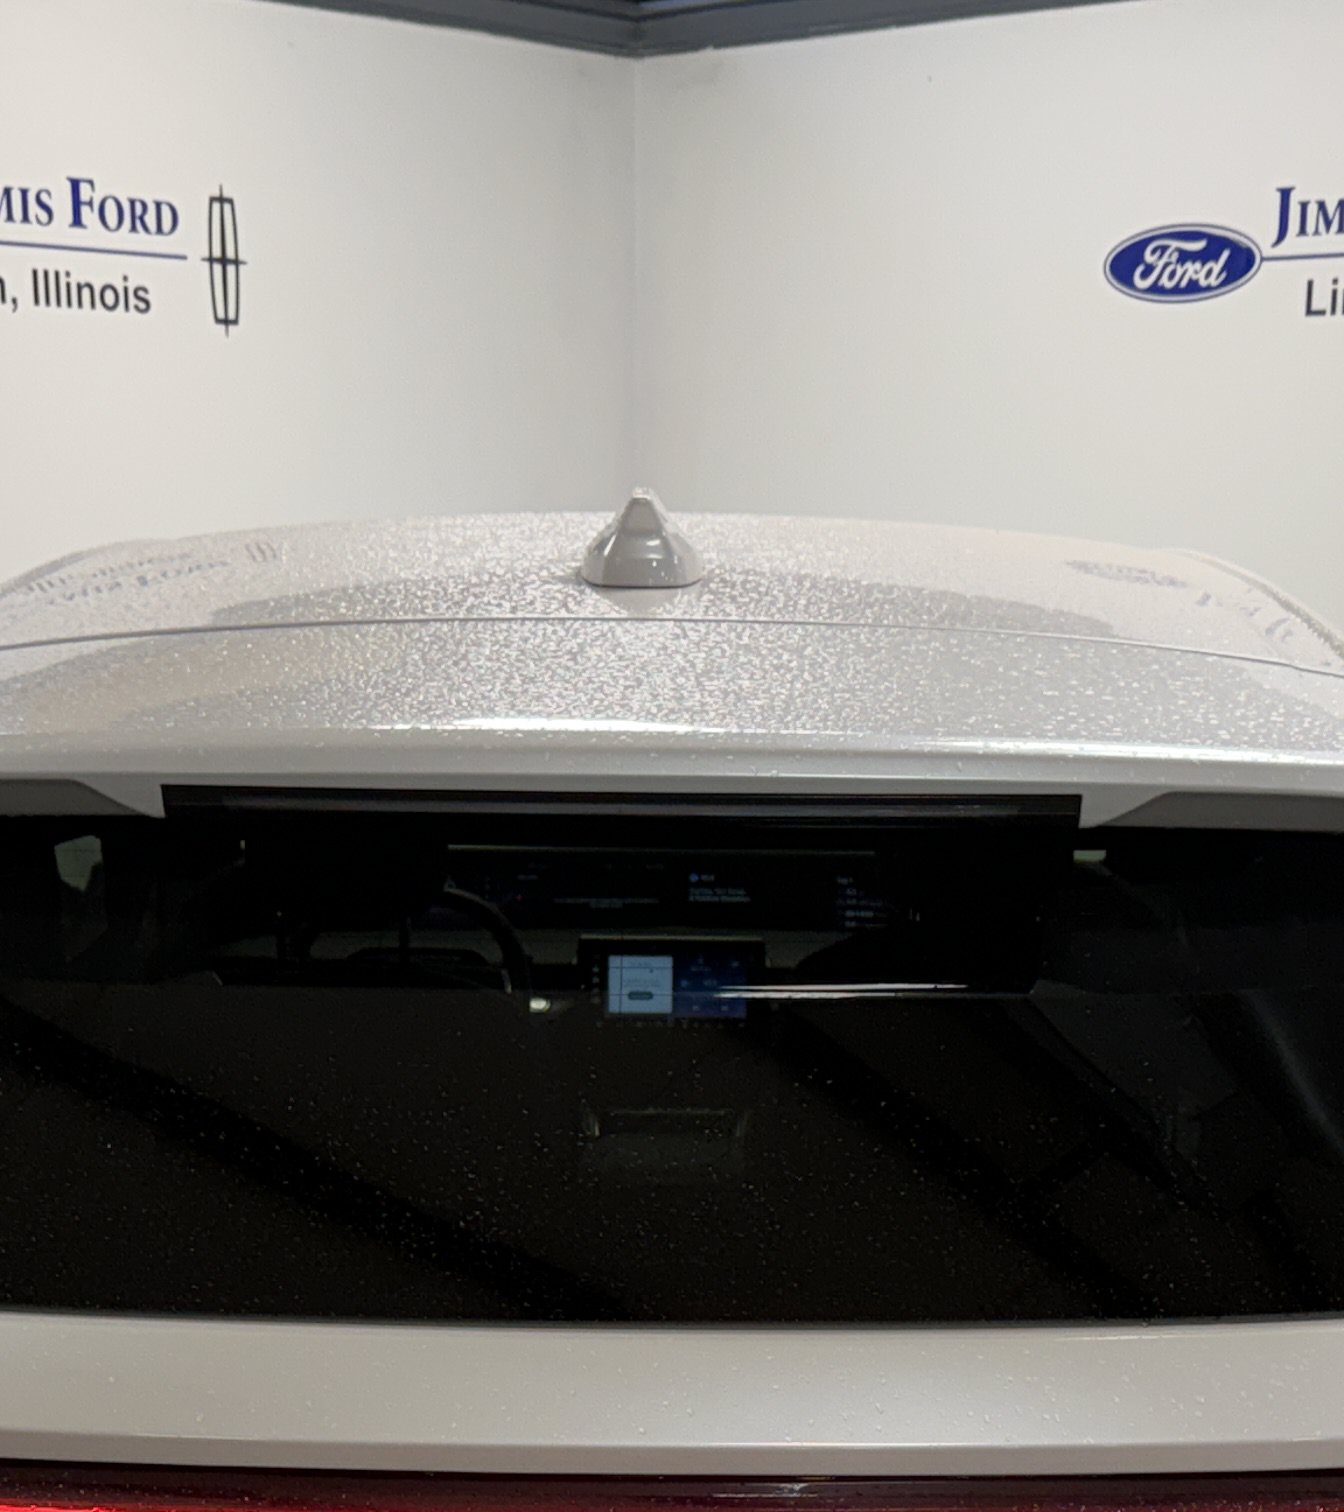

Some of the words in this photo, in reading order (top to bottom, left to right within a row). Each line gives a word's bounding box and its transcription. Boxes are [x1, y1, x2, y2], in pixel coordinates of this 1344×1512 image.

[67, 177, 178, 236] FORD
[1133, 236, 1226, 289] Ford
[32, 269, 150, 313] Illinois
